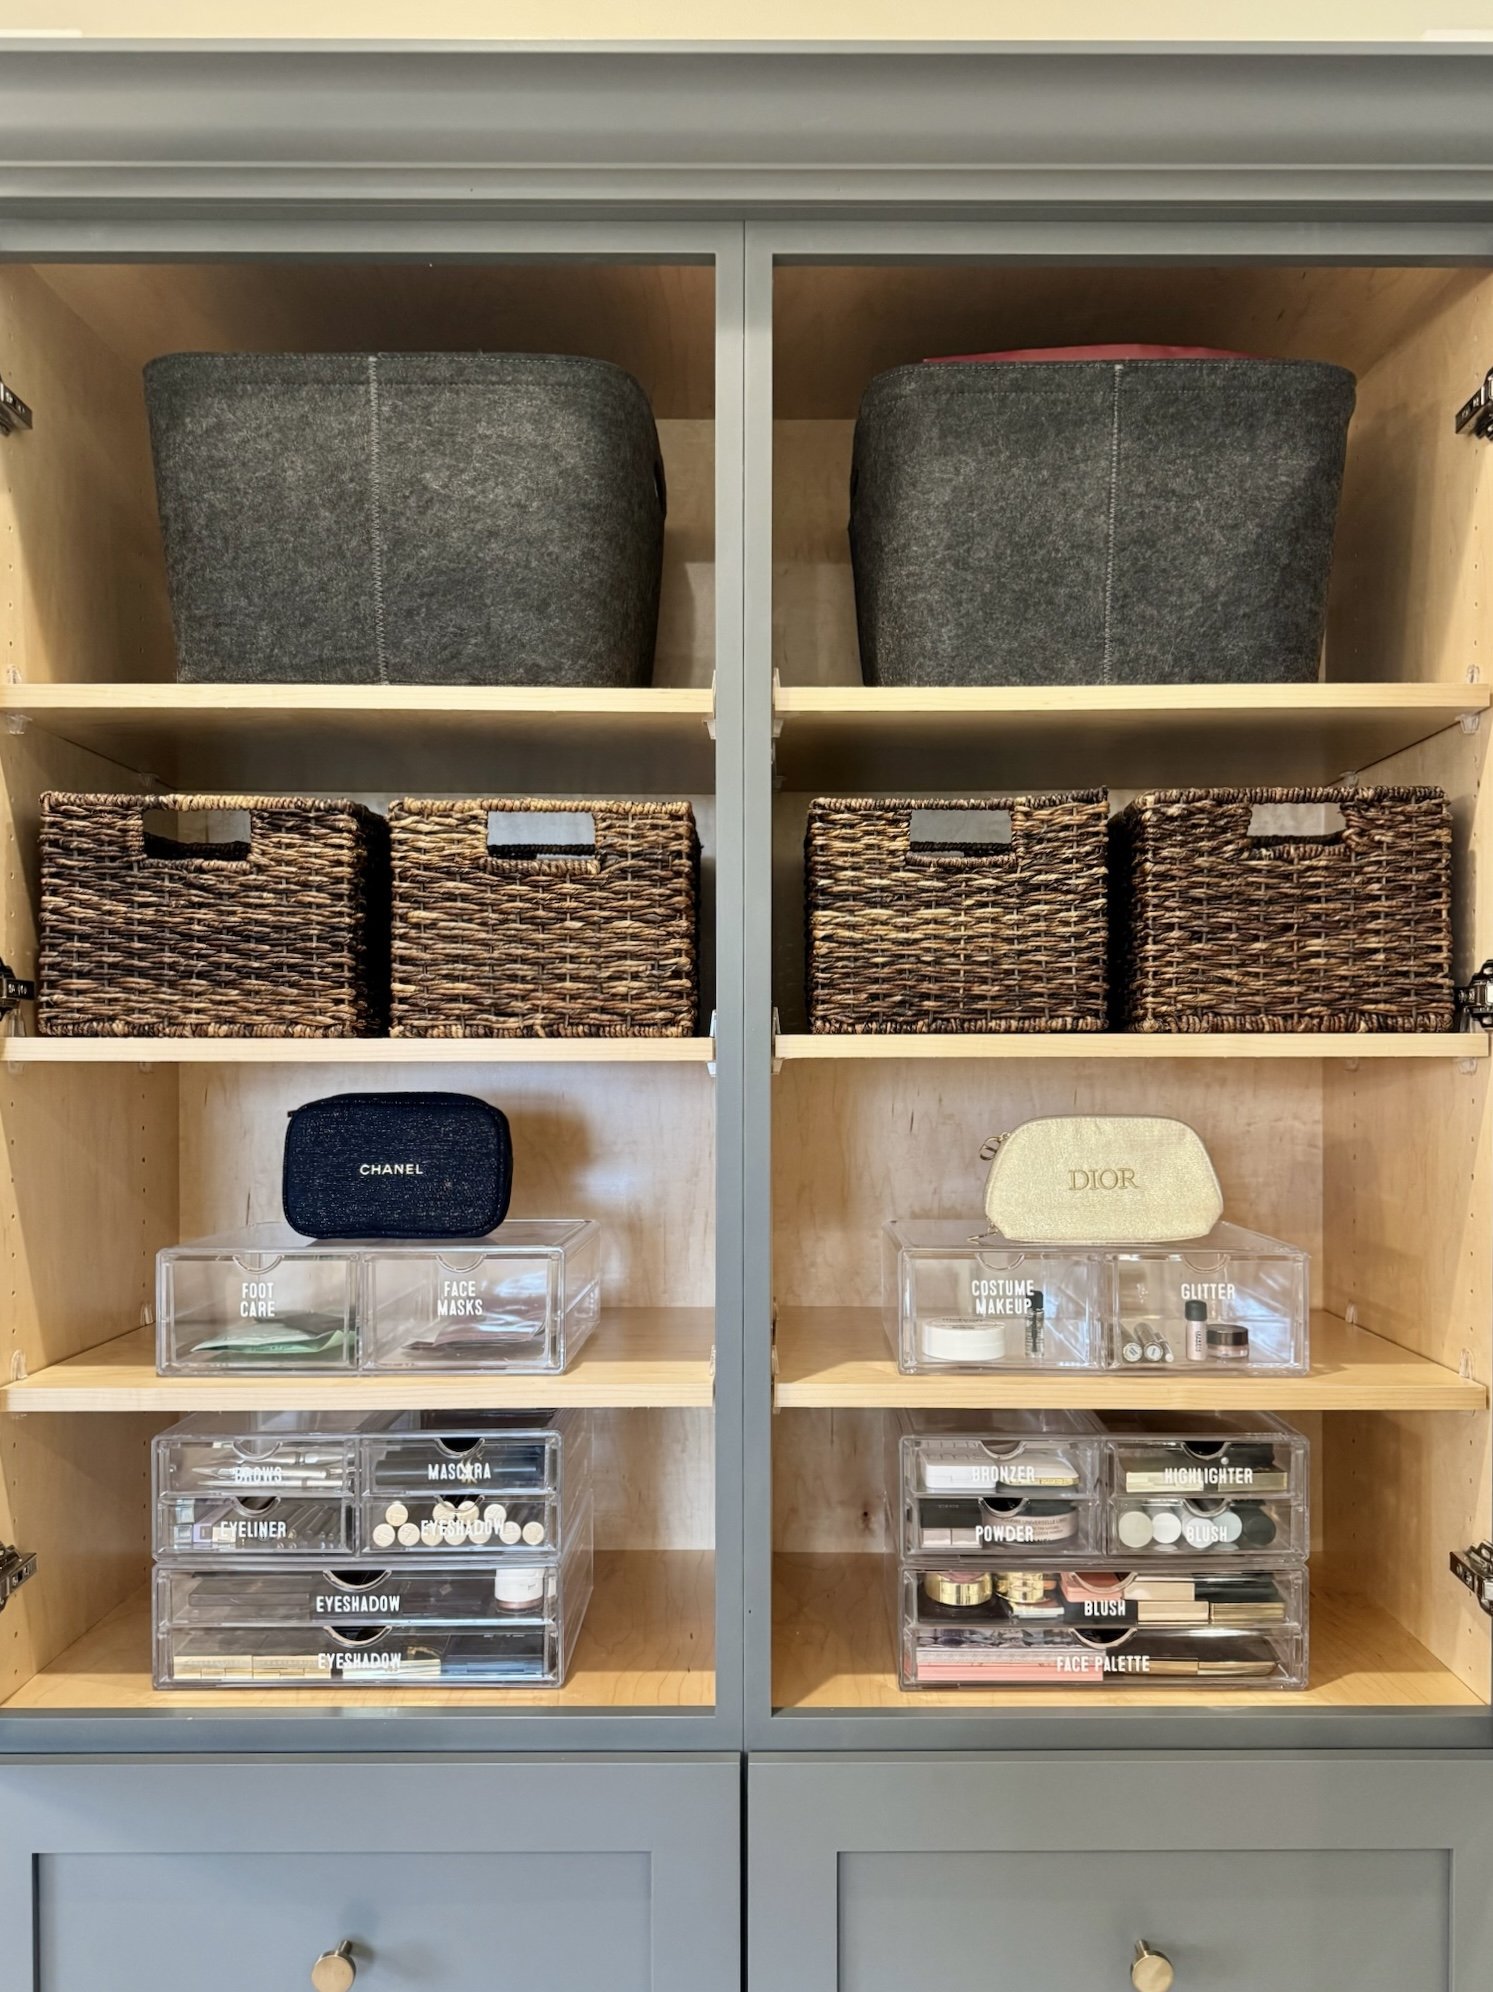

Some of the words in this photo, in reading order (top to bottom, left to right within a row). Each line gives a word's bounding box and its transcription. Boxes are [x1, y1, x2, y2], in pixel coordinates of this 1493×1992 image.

[360, 1163, 423, 1175] CHANEL
[1068, 1168, 1139, 1191] DIOR
[242, 1282, 274, 1298] FOOT
[444, 1281, 476, 1297] FACE
[971, 1280, 1034, 1297] COSTUME
[1181, 1283, 1236, 1300] GLITTER
[240, 1300, 275, 1317] CARE
[437, 1299, 483, 1316] MASKS
[975, 1297, 1032, 1315] MAKEUP
[235, 1466, 283, 1483] BROWS
[428, 1463, 491, 1481] MASCARA
[971, 1466, 1036, 1483] BRONZER
[1164, 1467, 1253, 1484] HIGHLIGHTER
[220, 1521, 287, 1538] EYELINER
[420, 1519, 505, 1536] EYESHADOW
[975, 1525, 1034, 1543] POWDER
[1186, 1525, 1228, 1543] BLUSH
[316, 1595, 400, 1612] EYESHADOW
[1084, 1600, 1126, 1616] BLUSH
[318, 1652, 402, 1670] EYESHADOW
[1056, 1655, 1091, 1673] FACE
[1094, 1655, 1150, 1672] PALETTE
